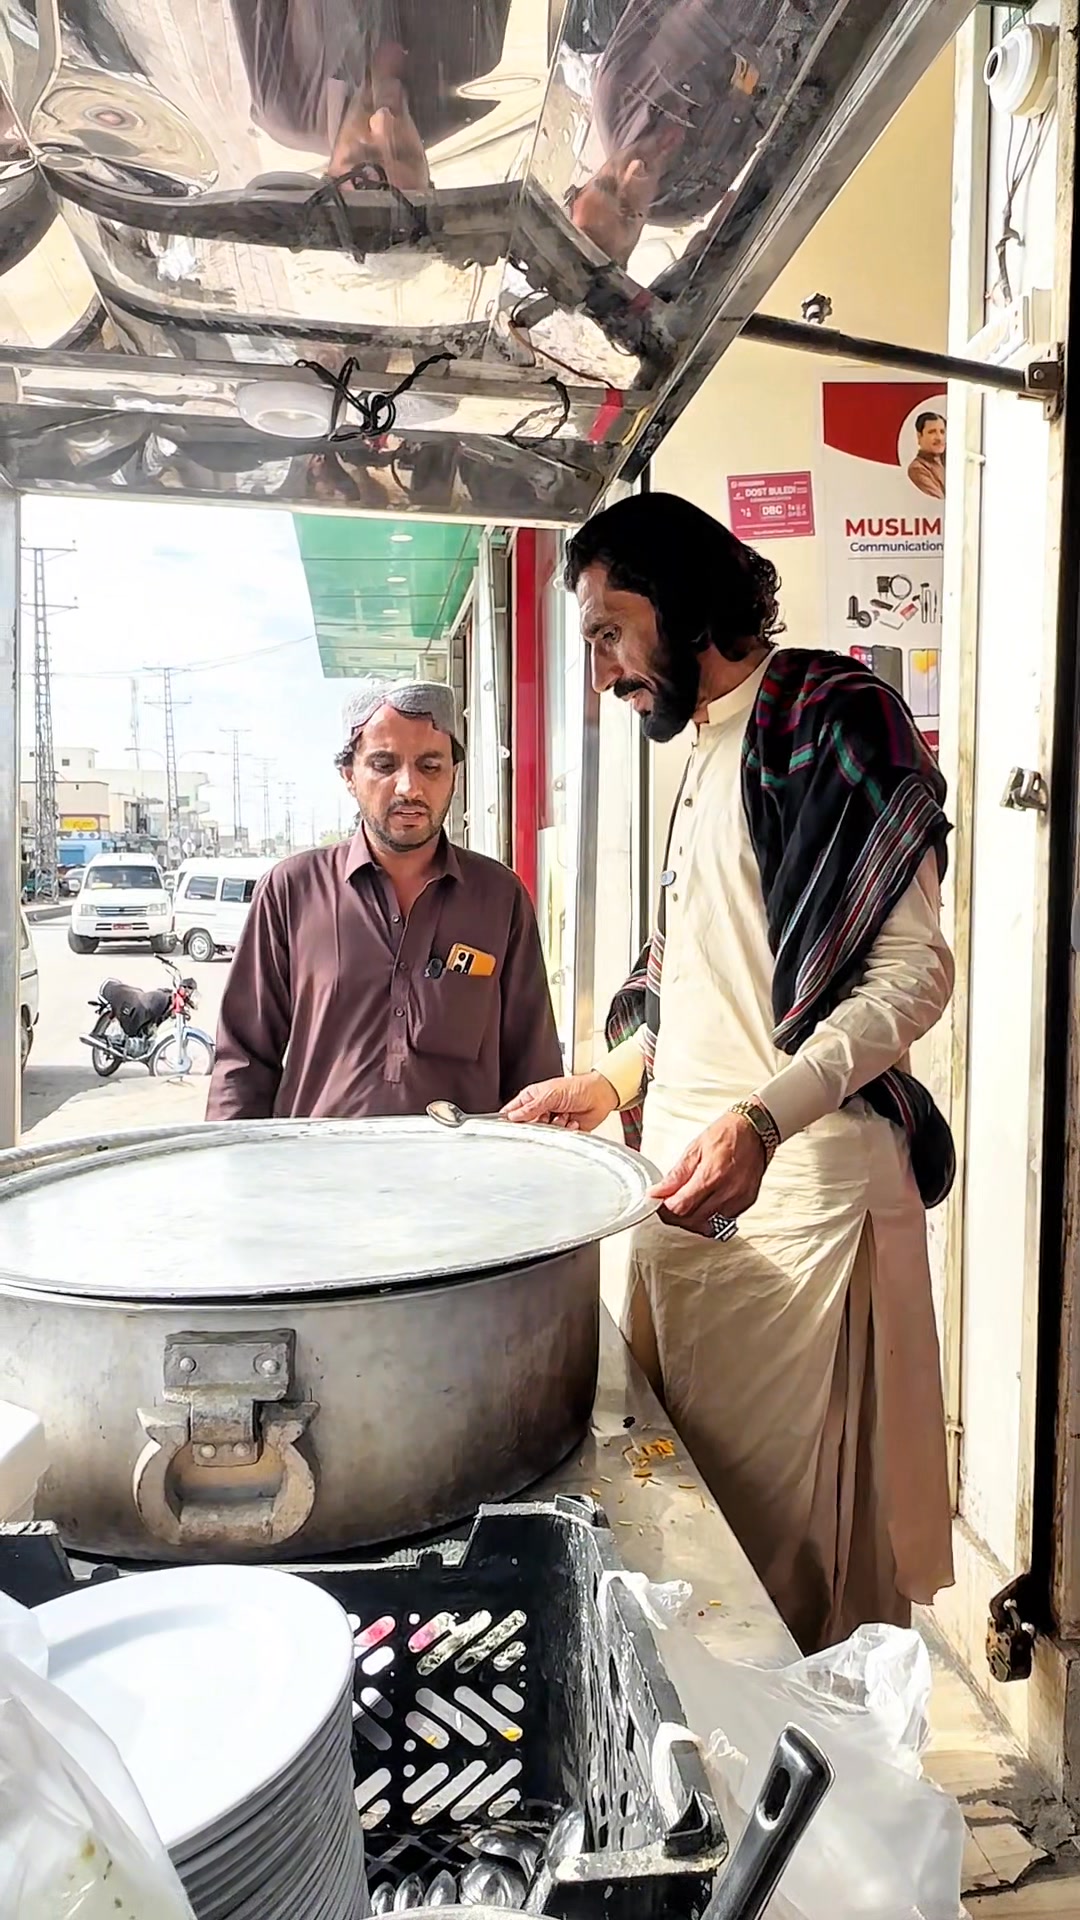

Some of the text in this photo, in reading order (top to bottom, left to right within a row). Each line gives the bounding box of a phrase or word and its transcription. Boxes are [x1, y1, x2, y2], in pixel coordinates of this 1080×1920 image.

[745, 487, 767, 497] DOST
[762, 505, 783, 515] DBC
[845, 518, 941, 536] MUSLIM
[850, 541, 944, 552] Communication
